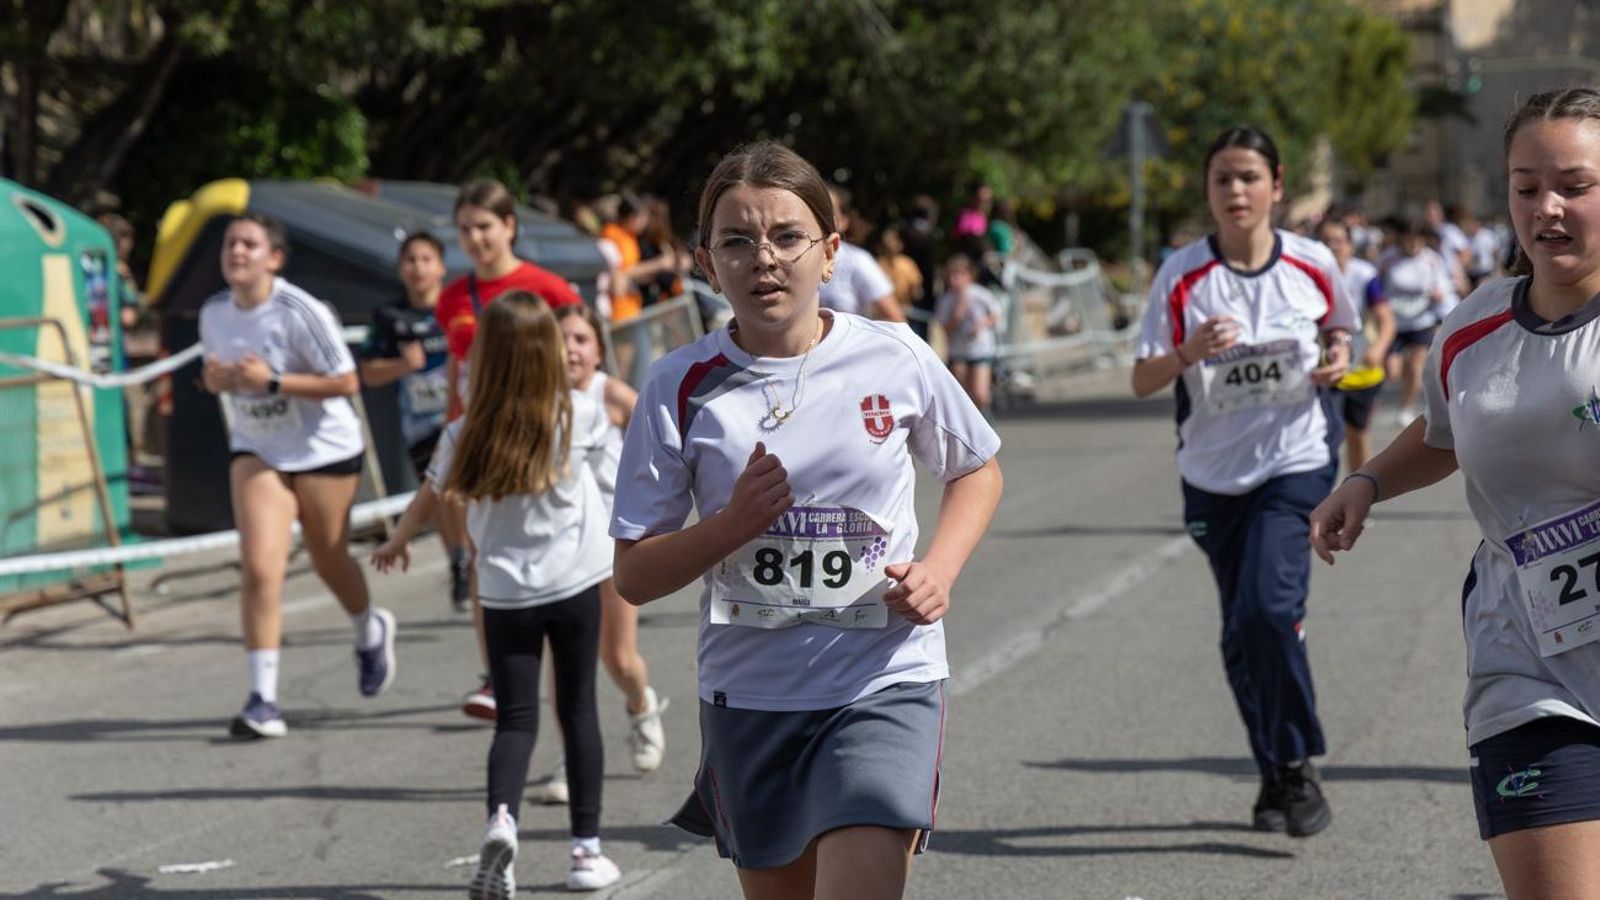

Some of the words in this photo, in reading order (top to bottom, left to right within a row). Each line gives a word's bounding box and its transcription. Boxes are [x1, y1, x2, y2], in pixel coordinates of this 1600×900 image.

[1226, 361, 1281, 386] 404
[808, 511, 847, 523] CARRERA
[816, 523, 828, 534] LA
[836, 521, 873, 535] GLORIA
[753, 547, 852, 589] 819
[1550, 551, 1600, 606] 27
